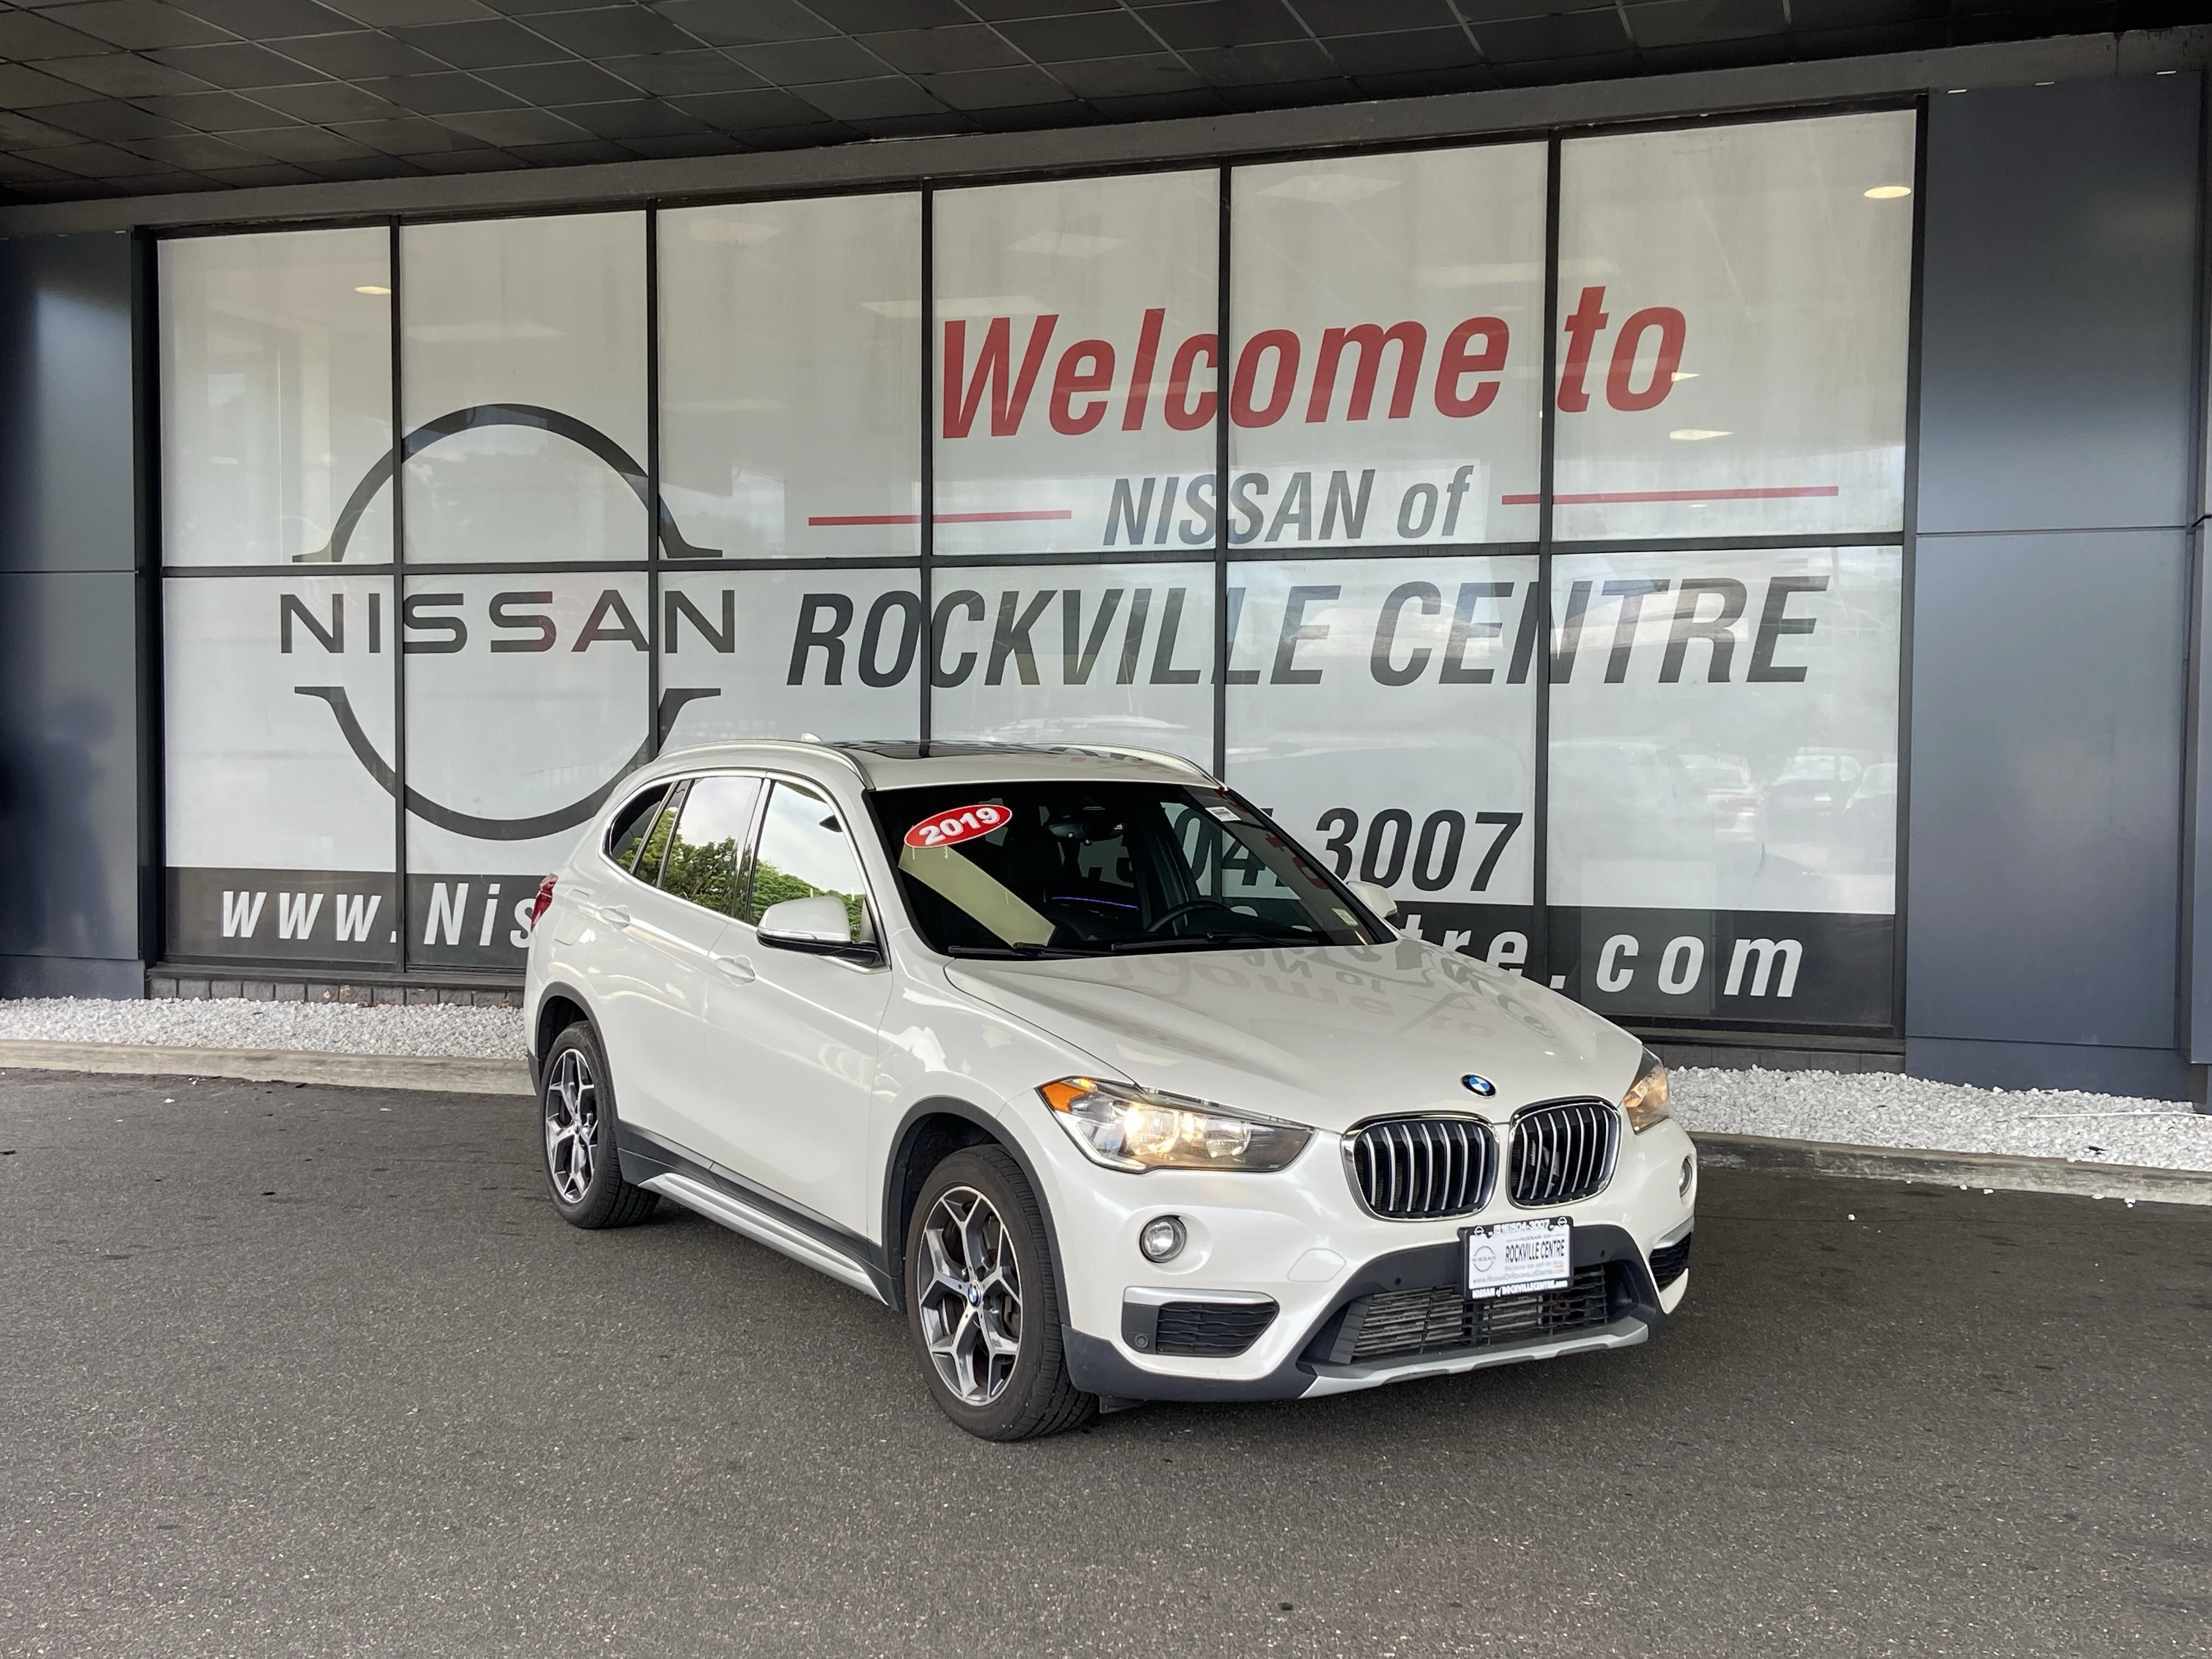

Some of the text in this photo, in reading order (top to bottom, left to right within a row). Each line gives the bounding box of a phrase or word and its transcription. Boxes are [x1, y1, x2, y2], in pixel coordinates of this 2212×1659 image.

[943, 286, 1686, 439] Welcome to
[1103, 465, 1474, 545] NISSAN of
[280, 590, 735, 653] NISSAN
[786, 575, 1830, 688] ROCKVILLE CENTRE
[919, 808, 1000, 845] 2019
[1505, 1239, 1565, 1262] ROCKVILLE CENTRE
